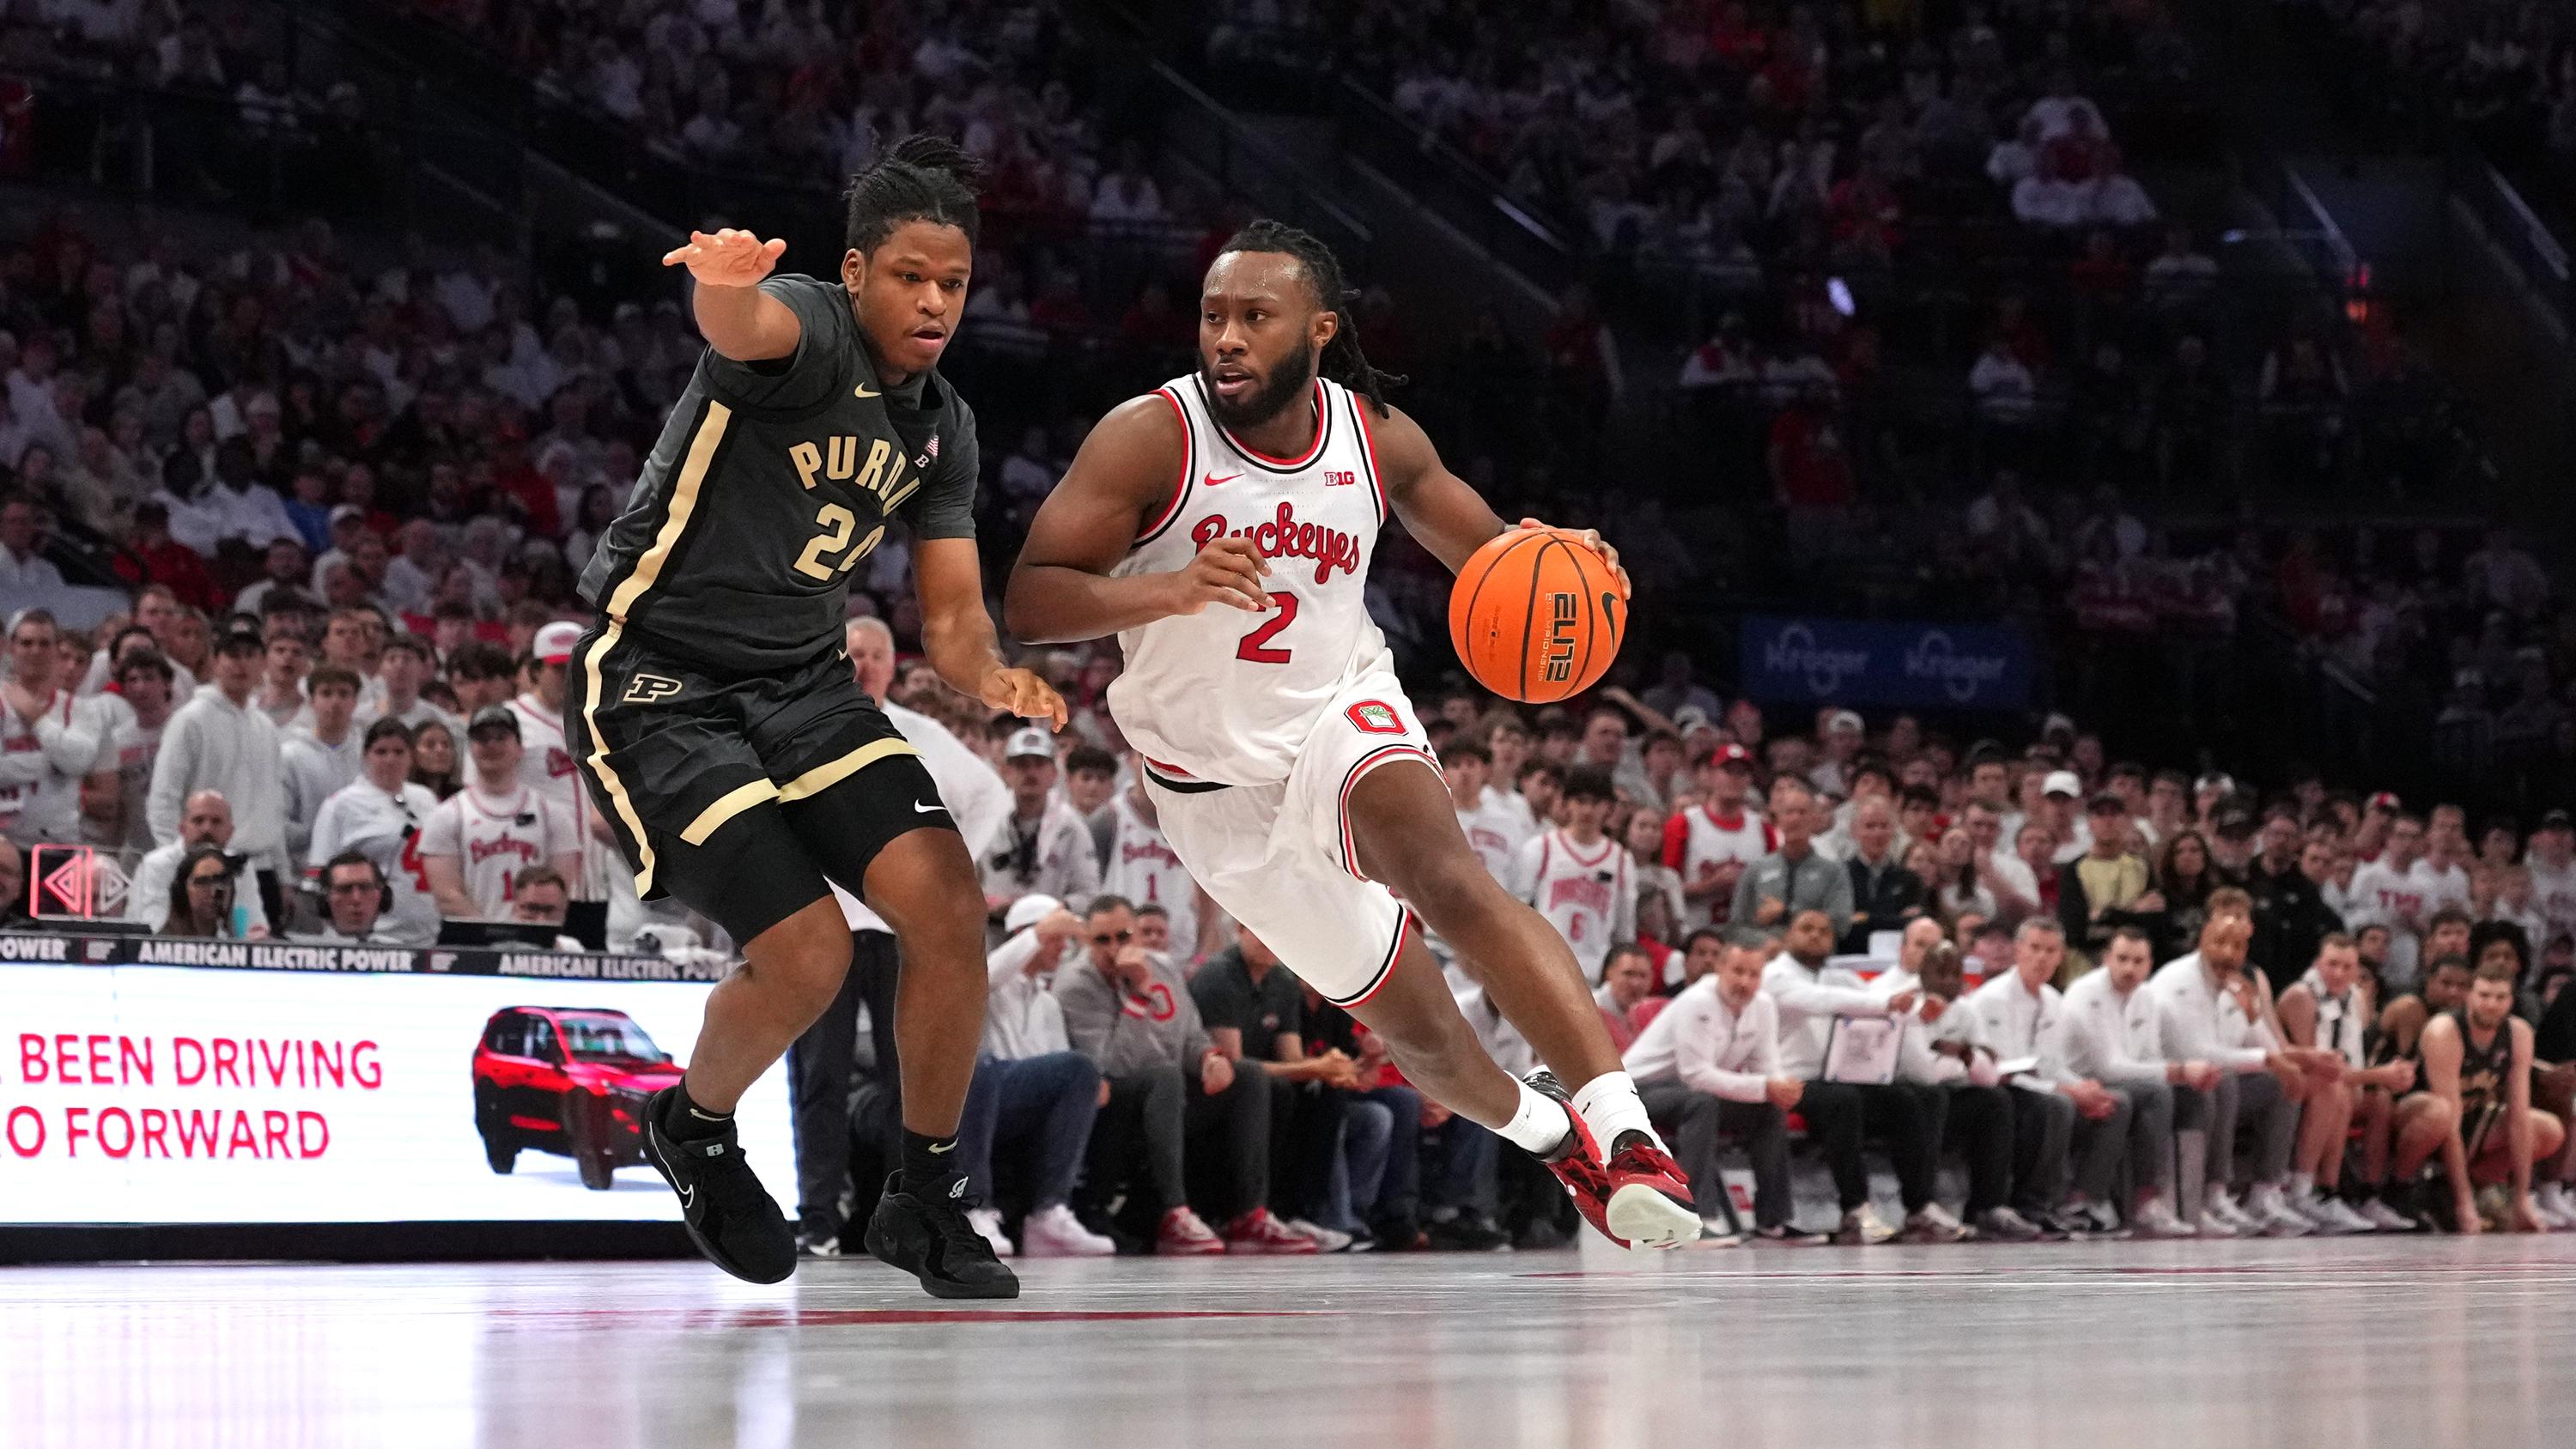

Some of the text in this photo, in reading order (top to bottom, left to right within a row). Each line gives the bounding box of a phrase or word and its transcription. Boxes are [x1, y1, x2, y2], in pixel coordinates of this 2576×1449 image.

[1236, 591, 1299, 664] 2
[1545, 591, 1577, 682] ELITE
[623, 673, 683, 702] P
[0, 937, 66, 961] OWER
[138, 941, 247, 967] AMERICAN
[252, 946, 337, 970] ELECTRIC
[342, 949, 412, 972] POWER
[498, 954, 598, 978] AMERICAN
[602, 956, 678, 980] ELECTRIC
[19, 1034, 383, 1089] BEEN DRIVING
[0, 1106, 330, 1159] O FORWARD
